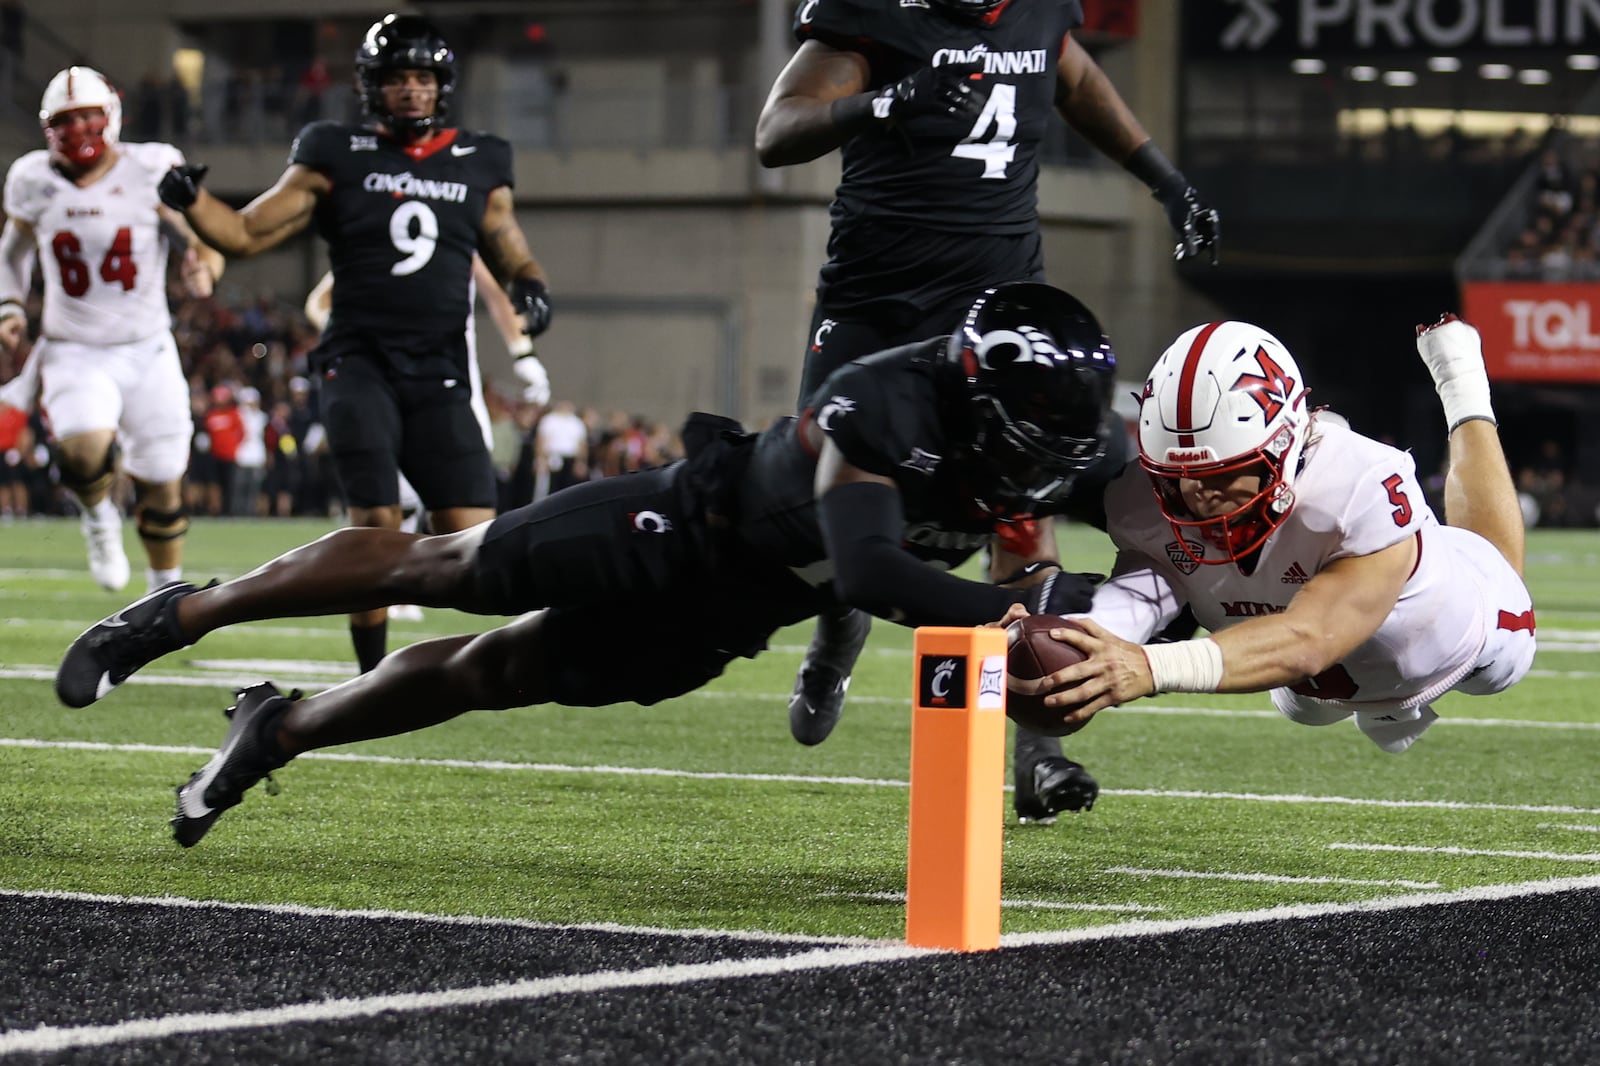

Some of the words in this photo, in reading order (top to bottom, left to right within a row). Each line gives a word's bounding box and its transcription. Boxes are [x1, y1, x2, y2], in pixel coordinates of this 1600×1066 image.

[951, 83, 1018, 179] 4
[363, 170, 468, 203] CINCINNATI
[52, 226, 137, 297] 64
[389, 200, 439, 276] 9
[1503, 299, 1600, 350] TQL
[1381, 473, 1413, 528] 5
